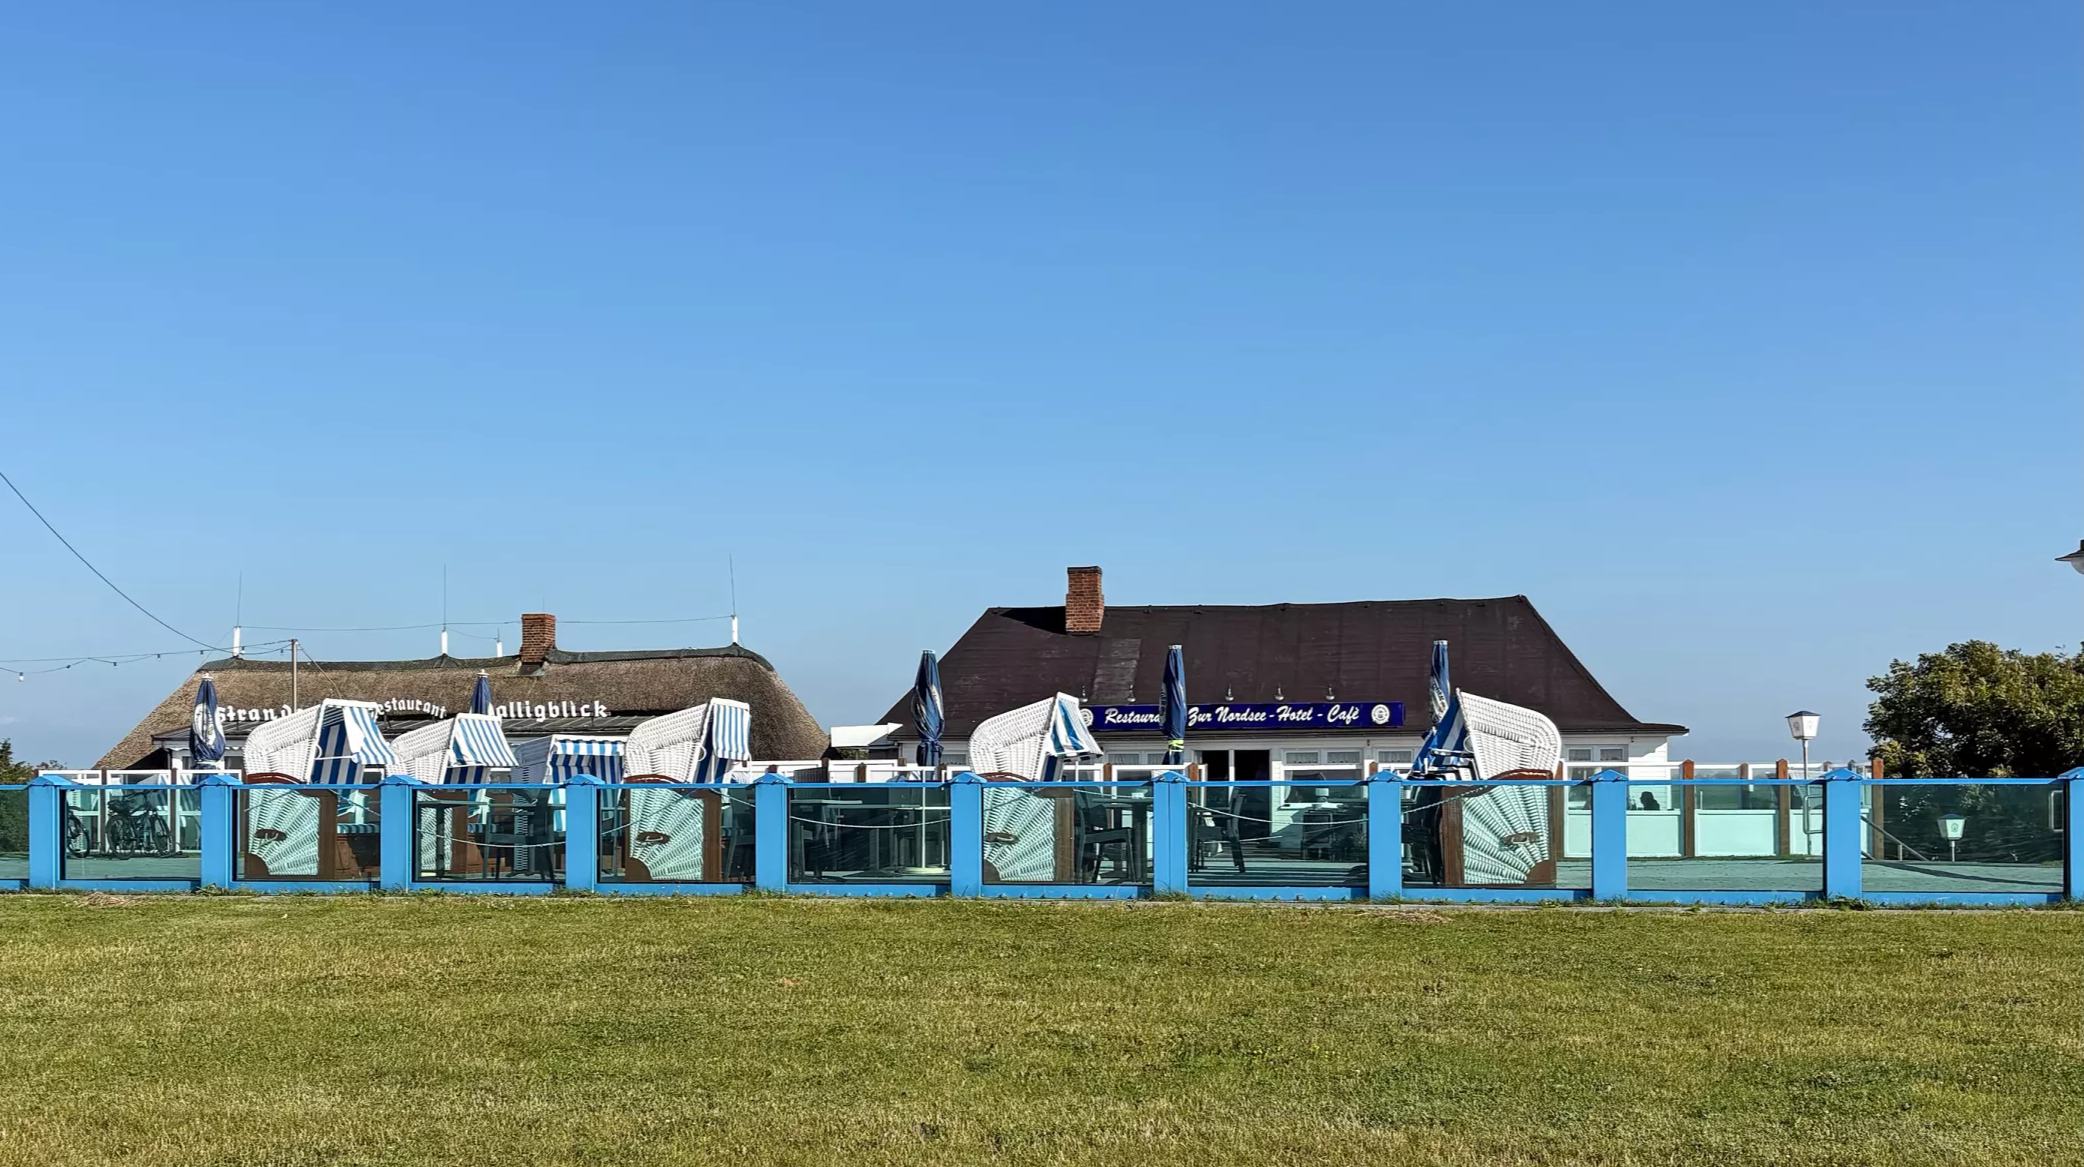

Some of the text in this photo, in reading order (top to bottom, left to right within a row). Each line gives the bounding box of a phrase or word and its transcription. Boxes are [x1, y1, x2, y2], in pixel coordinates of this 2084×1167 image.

[374, 697, 447, 719] estaurant
[495, 700, 607, 722] alligblick
[1104, 707, 1161, 725] Restaura
[1188, 706, 1212, 727] Zur
[1215, 705, 1267, 723] Nordsee
[1276, 705, 1313, 721] Hotel
